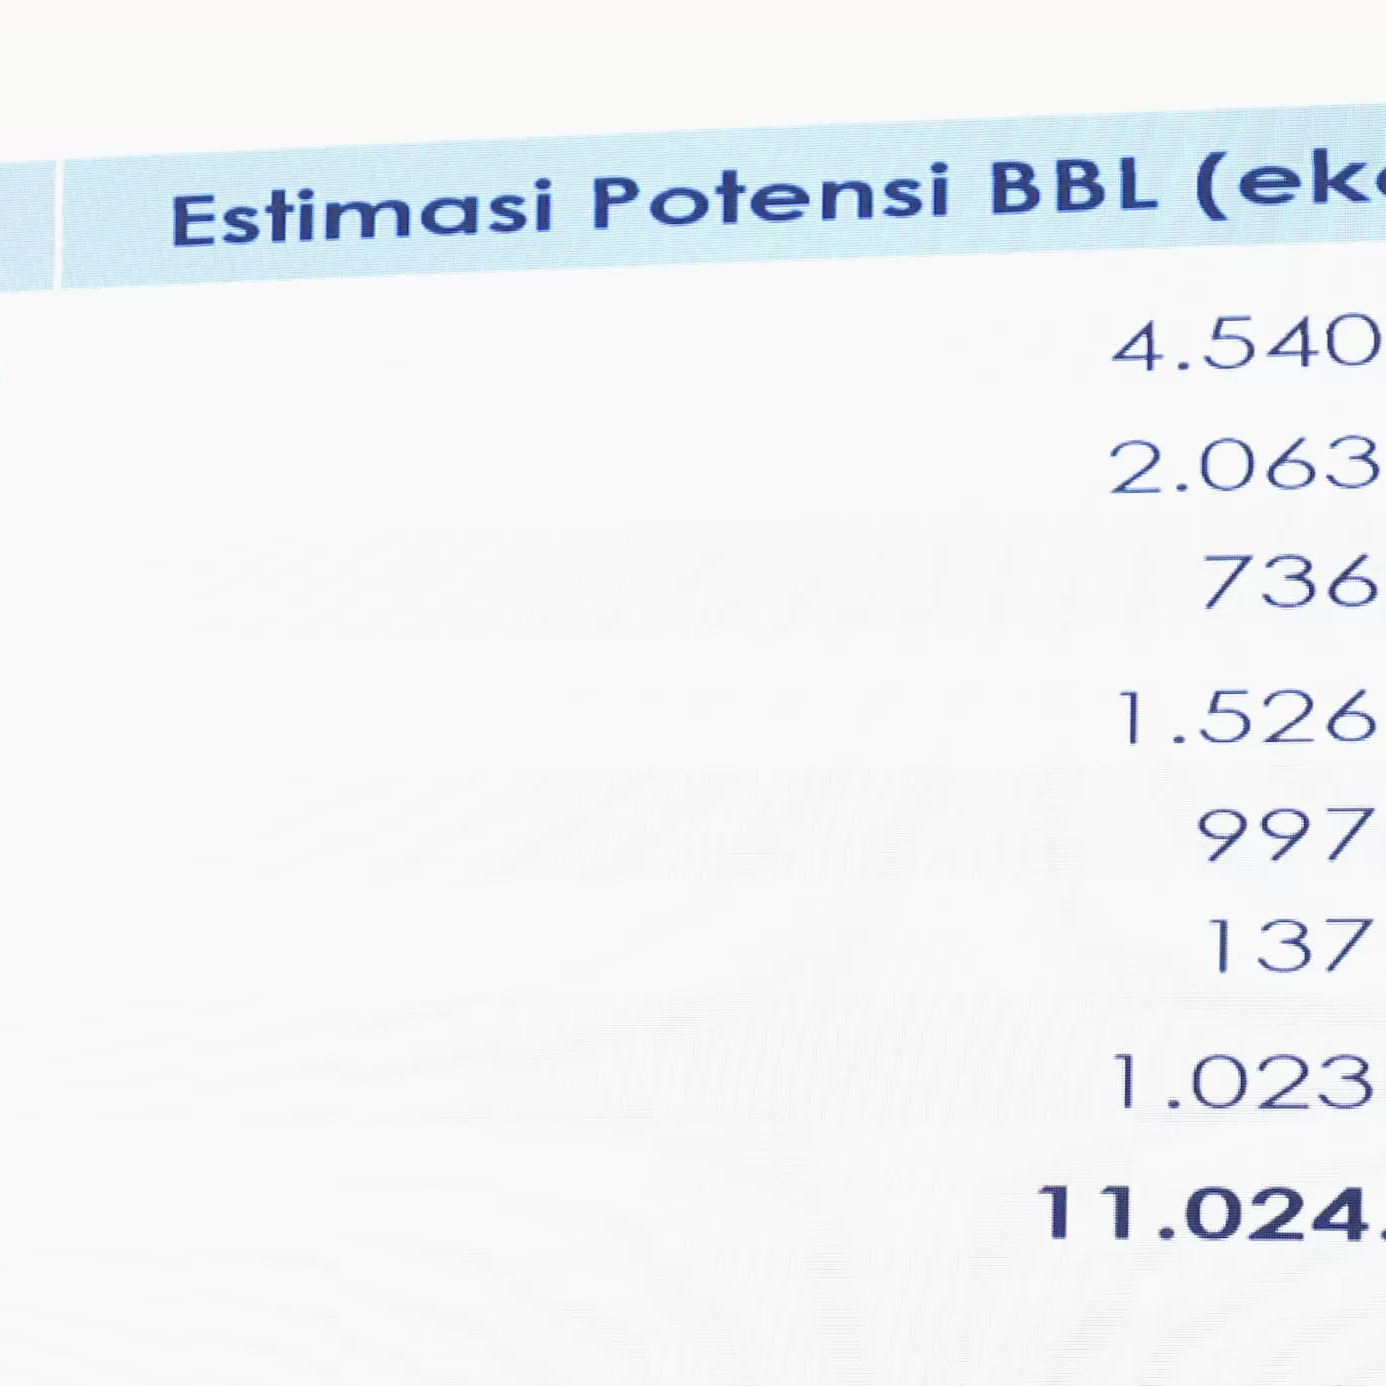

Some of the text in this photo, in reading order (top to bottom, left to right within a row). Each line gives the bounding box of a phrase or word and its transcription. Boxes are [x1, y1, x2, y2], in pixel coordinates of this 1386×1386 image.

[173, 178, 551, 247] Estimasi
[594, 162, 948, 230] Potensi
[992, 157, 1158, 215] BBL
